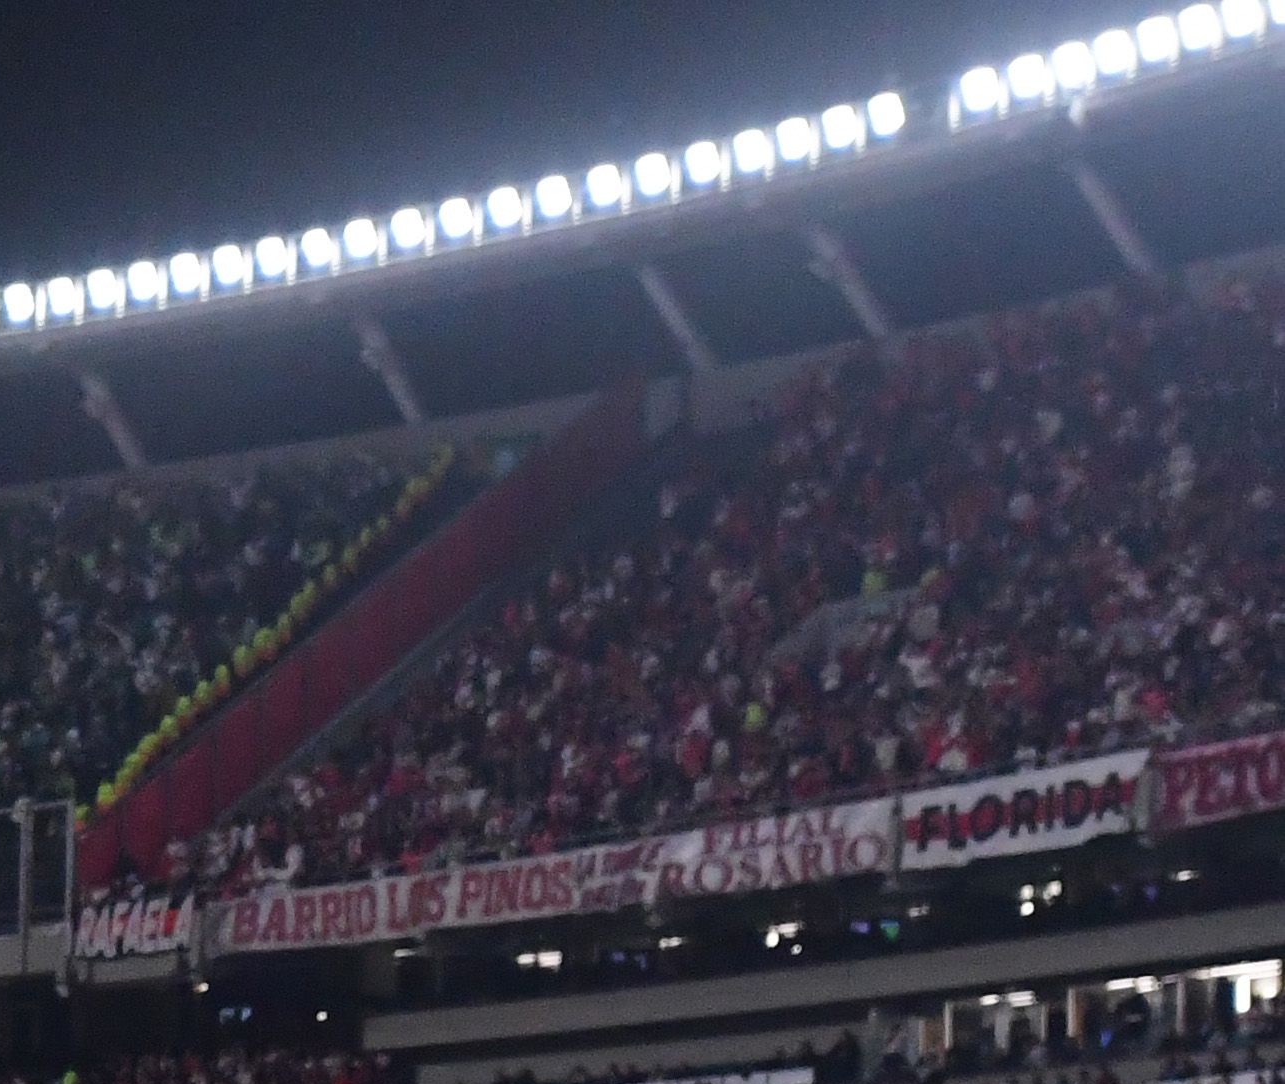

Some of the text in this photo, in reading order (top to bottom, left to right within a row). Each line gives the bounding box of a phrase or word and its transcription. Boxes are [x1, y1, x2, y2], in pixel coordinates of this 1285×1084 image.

[917, 772, 1123, 852] FLORIDA
[232, 884, 376, 945] BARRIO
[386, 875, 449, 932] LOS
[460, 860, 573, 918] PINOS
[659, 833, 887, 896] ROSARIO
